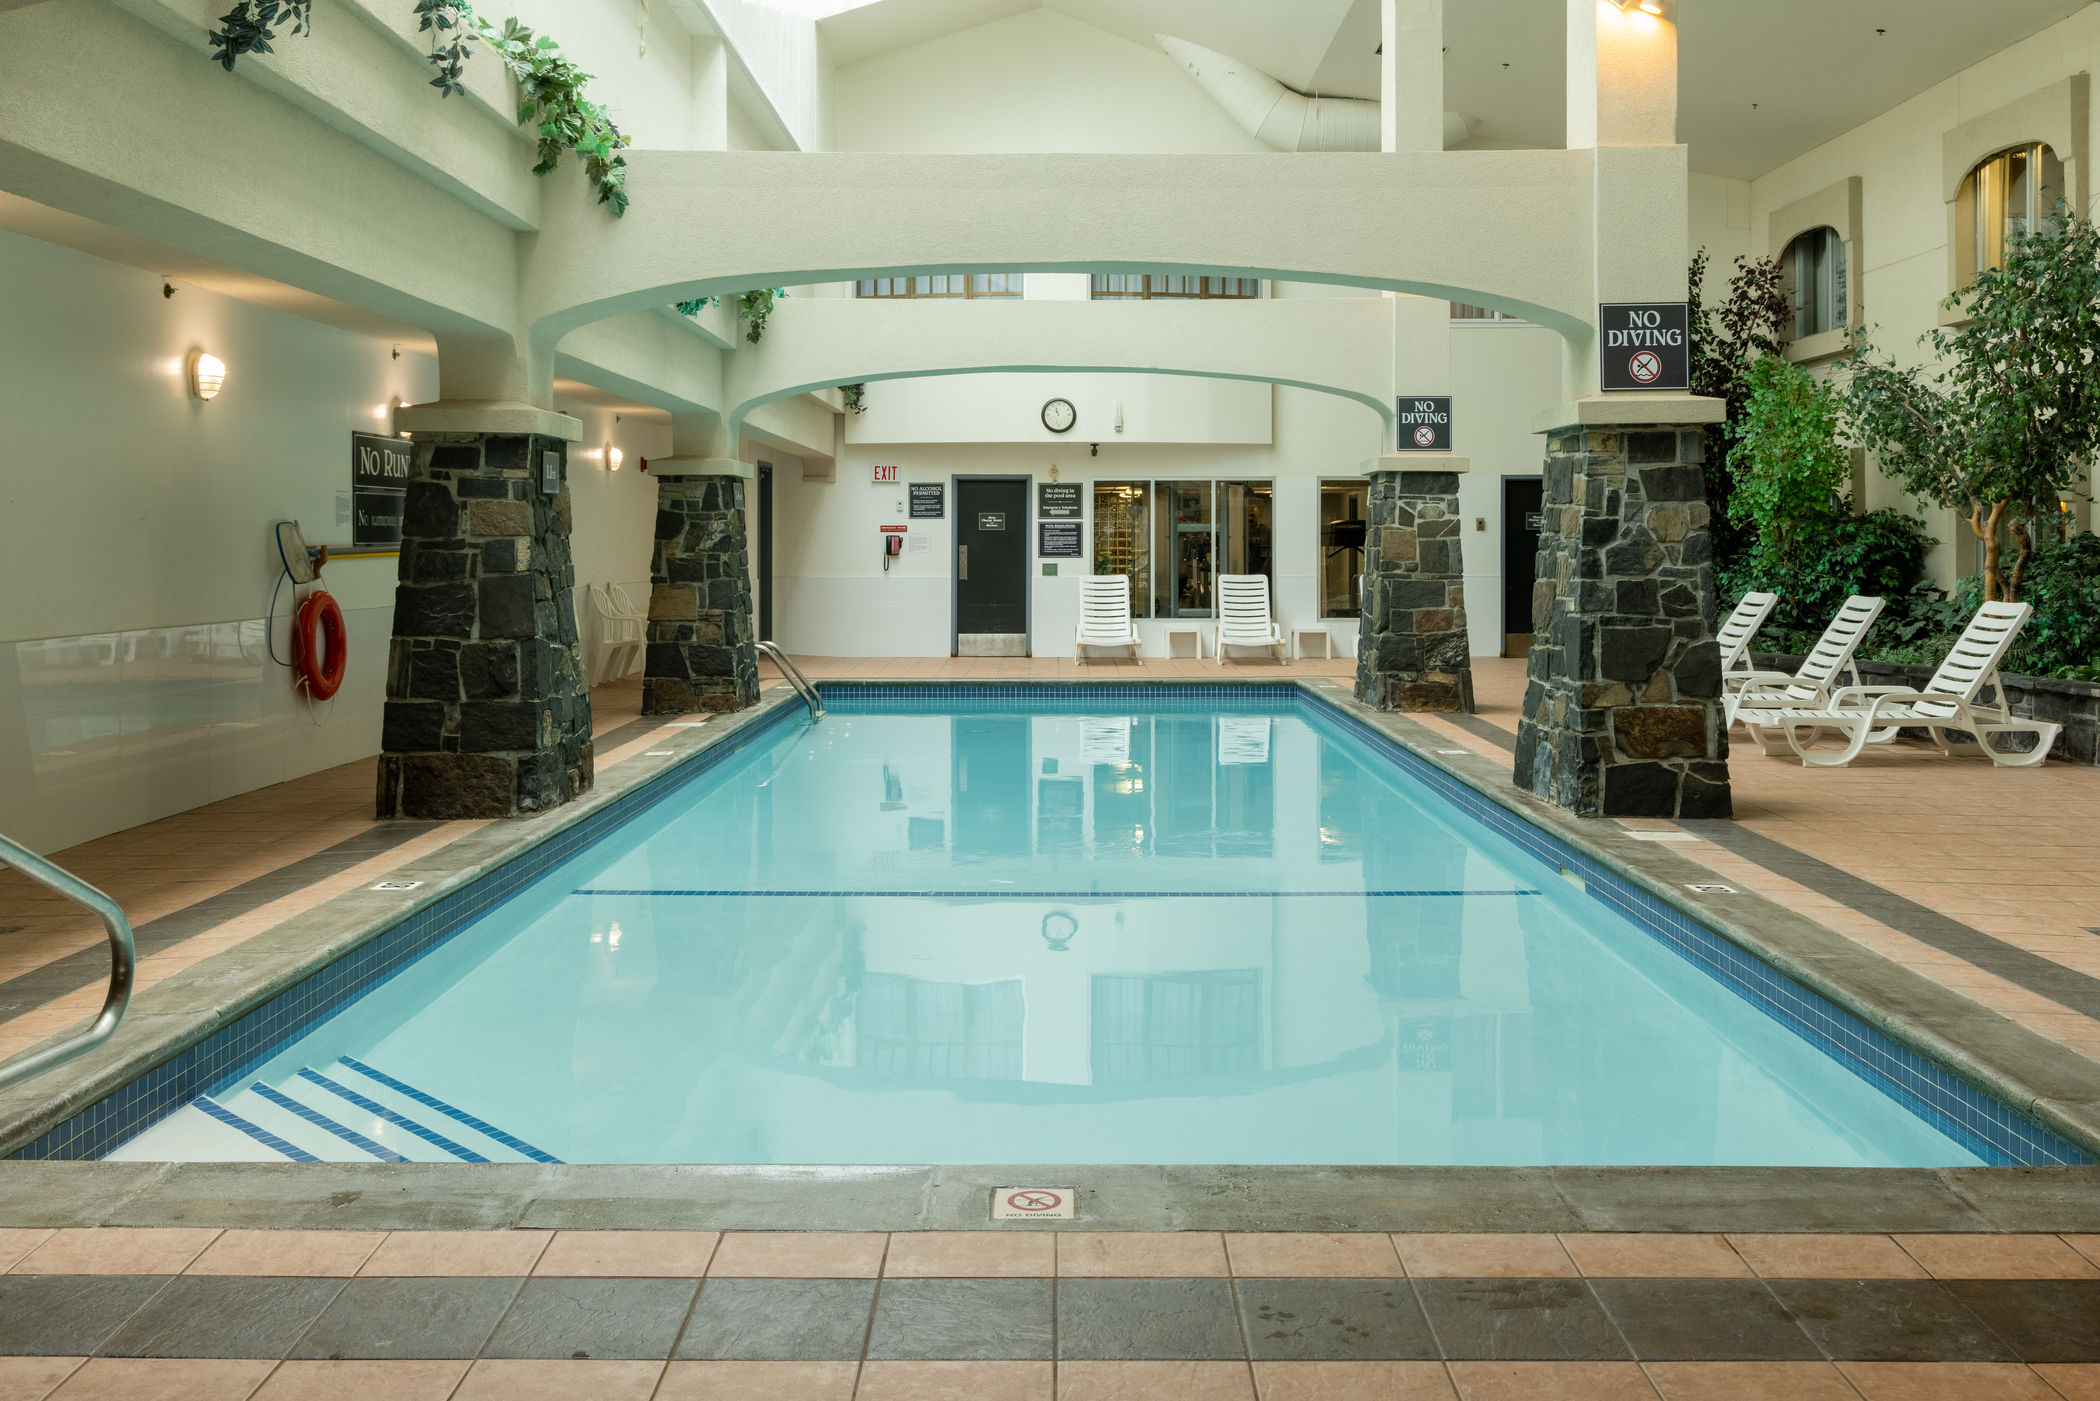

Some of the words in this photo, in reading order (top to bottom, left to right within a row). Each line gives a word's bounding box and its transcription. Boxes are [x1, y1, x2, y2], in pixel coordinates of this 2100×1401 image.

[1628, 310, 1661, 328] NO
[1607, 328, 1682, 347] DIVING
[1414, 400, 1435, 412] NO
[1401, 412, 1448, 424] DIVING
[383, 449, 411, 478] RUN
[874, 465, 897, 480] EXIT
